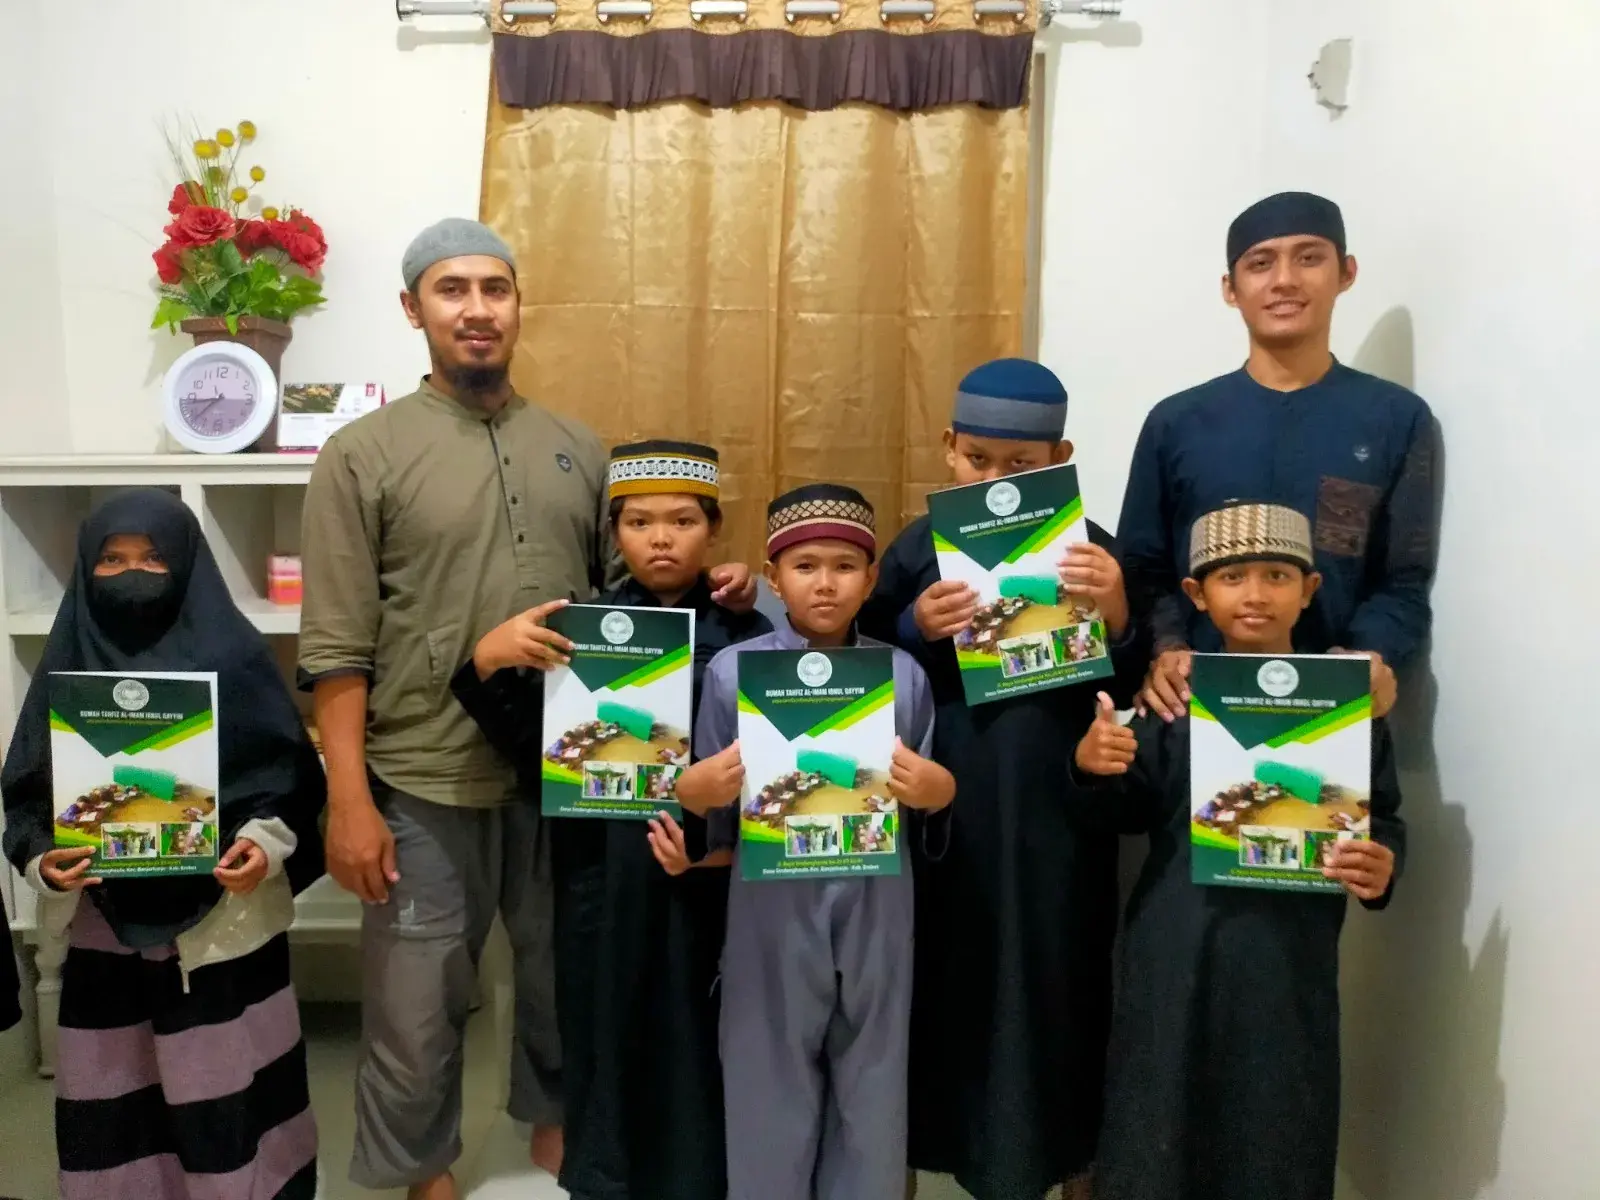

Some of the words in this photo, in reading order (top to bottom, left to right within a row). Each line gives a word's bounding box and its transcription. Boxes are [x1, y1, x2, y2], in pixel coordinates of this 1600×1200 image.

[216, 366, 229, 379] 12
[765, 689, 785, 697] RUMAH
[786, 688, 803, 697] TAHFIZ
[804, 688, 828, 696] AL-IMAM
[828, 687, 844, 695] IBNUL
[844, 686, 865, 695] QAYYIM
